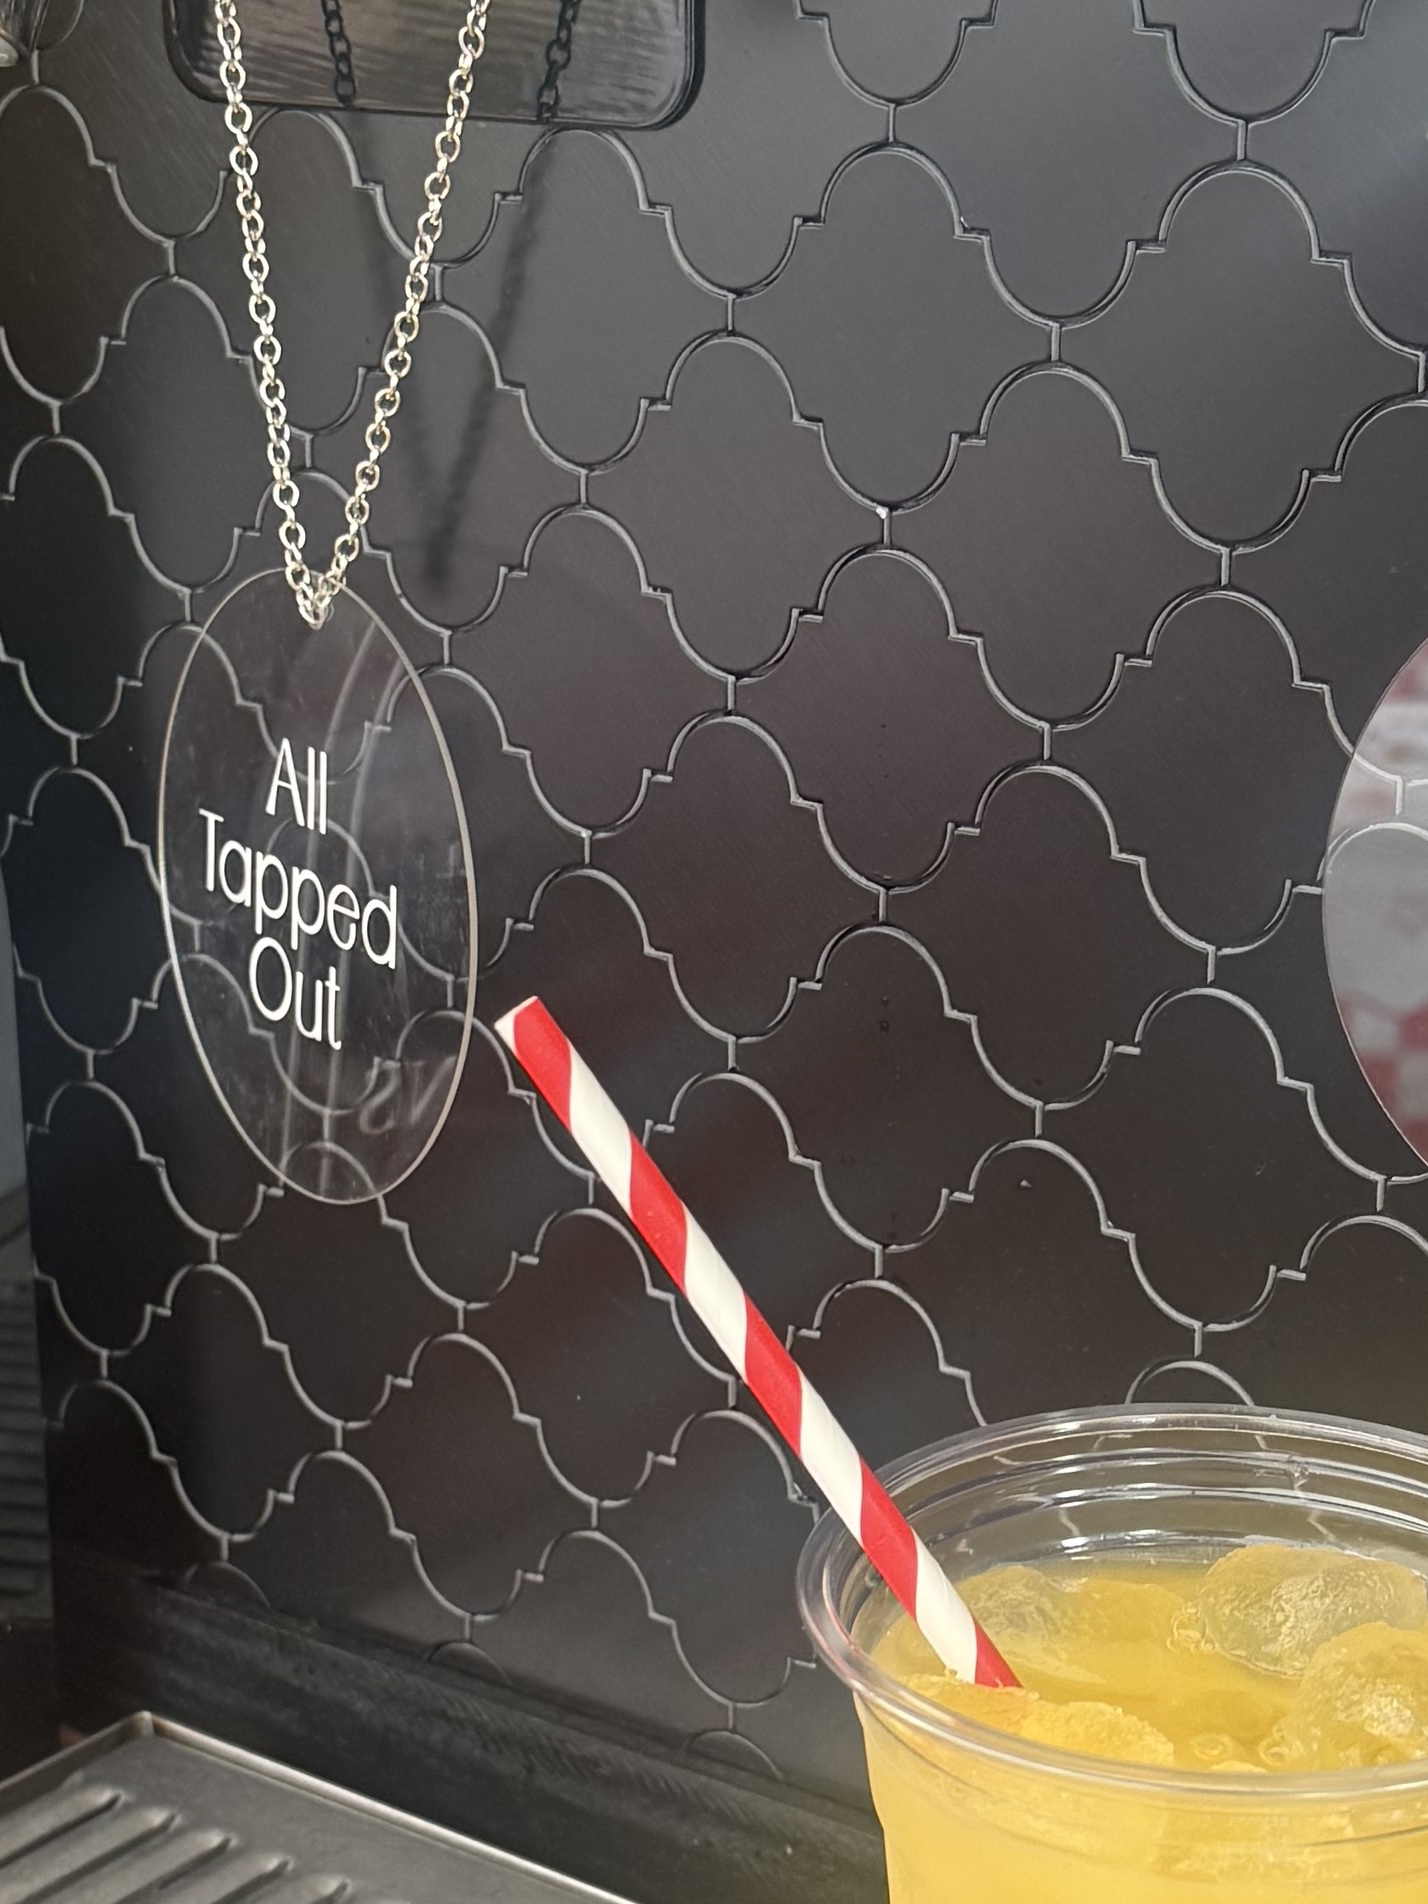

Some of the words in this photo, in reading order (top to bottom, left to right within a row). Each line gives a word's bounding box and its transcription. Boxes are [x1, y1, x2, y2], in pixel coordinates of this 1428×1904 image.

[264, 737, 328, 835] All
[199, 808, 397, 970] Tapped
[248, 936, 342, 1051] Out
